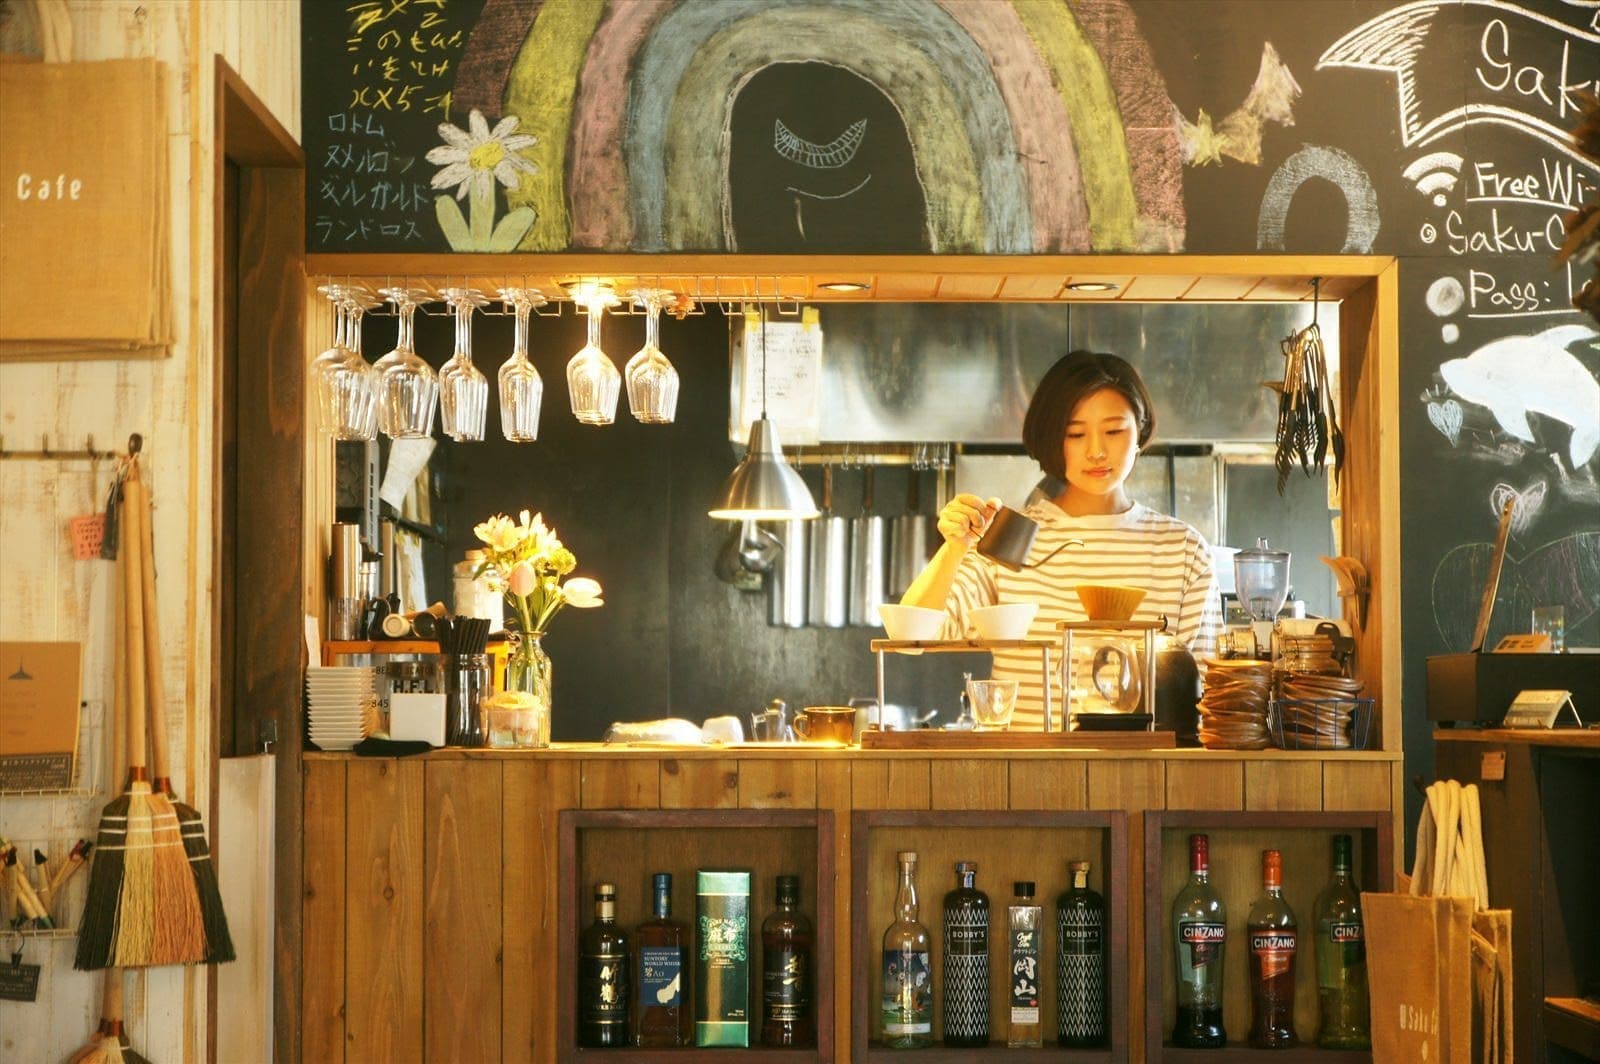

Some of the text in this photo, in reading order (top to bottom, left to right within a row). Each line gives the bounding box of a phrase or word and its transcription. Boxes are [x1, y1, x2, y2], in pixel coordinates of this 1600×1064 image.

[328, 112, 385, 136] ロトム
[17, 173, 82, 201] Cafe
[1474, 161, 1540, 199] Free
[316, 215, 423, 243] ランドロス
[952, 930, 985, 939] BOBBY'S
[1066, 930, 1099, 939] BOBBY'S
[1183, 926, 1225, 938] CINZANO
[1254, 936, 1295, 950] CINZANO
